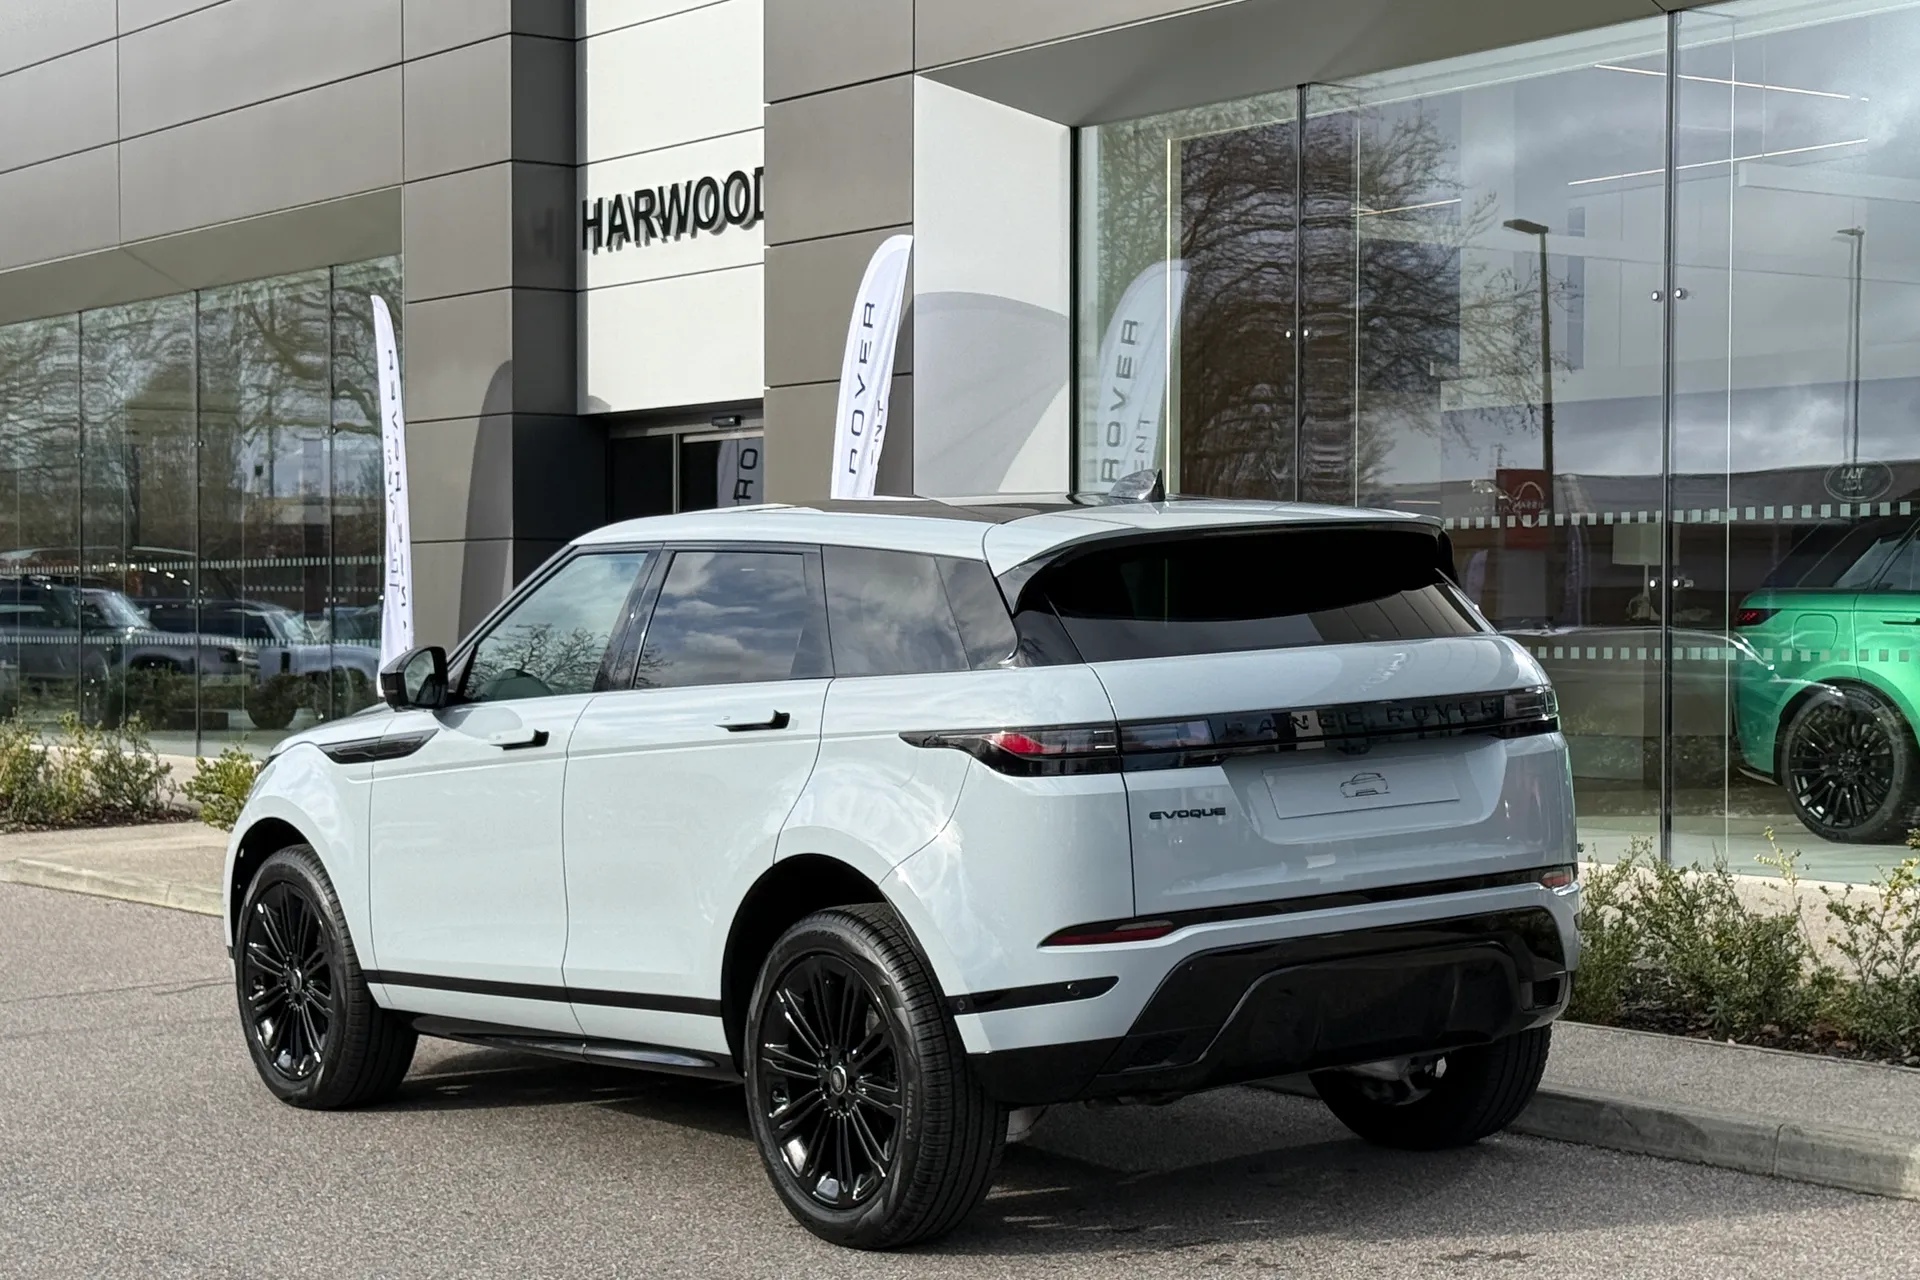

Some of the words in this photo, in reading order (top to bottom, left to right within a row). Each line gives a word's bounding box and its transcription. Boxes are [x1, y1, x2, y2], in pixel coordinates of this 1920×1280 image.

[848, 301, 876, 475] ROVER
[1101, 319, 1139, 483] ROVER
[1149, 807, 1226, 820] EVOQUE
